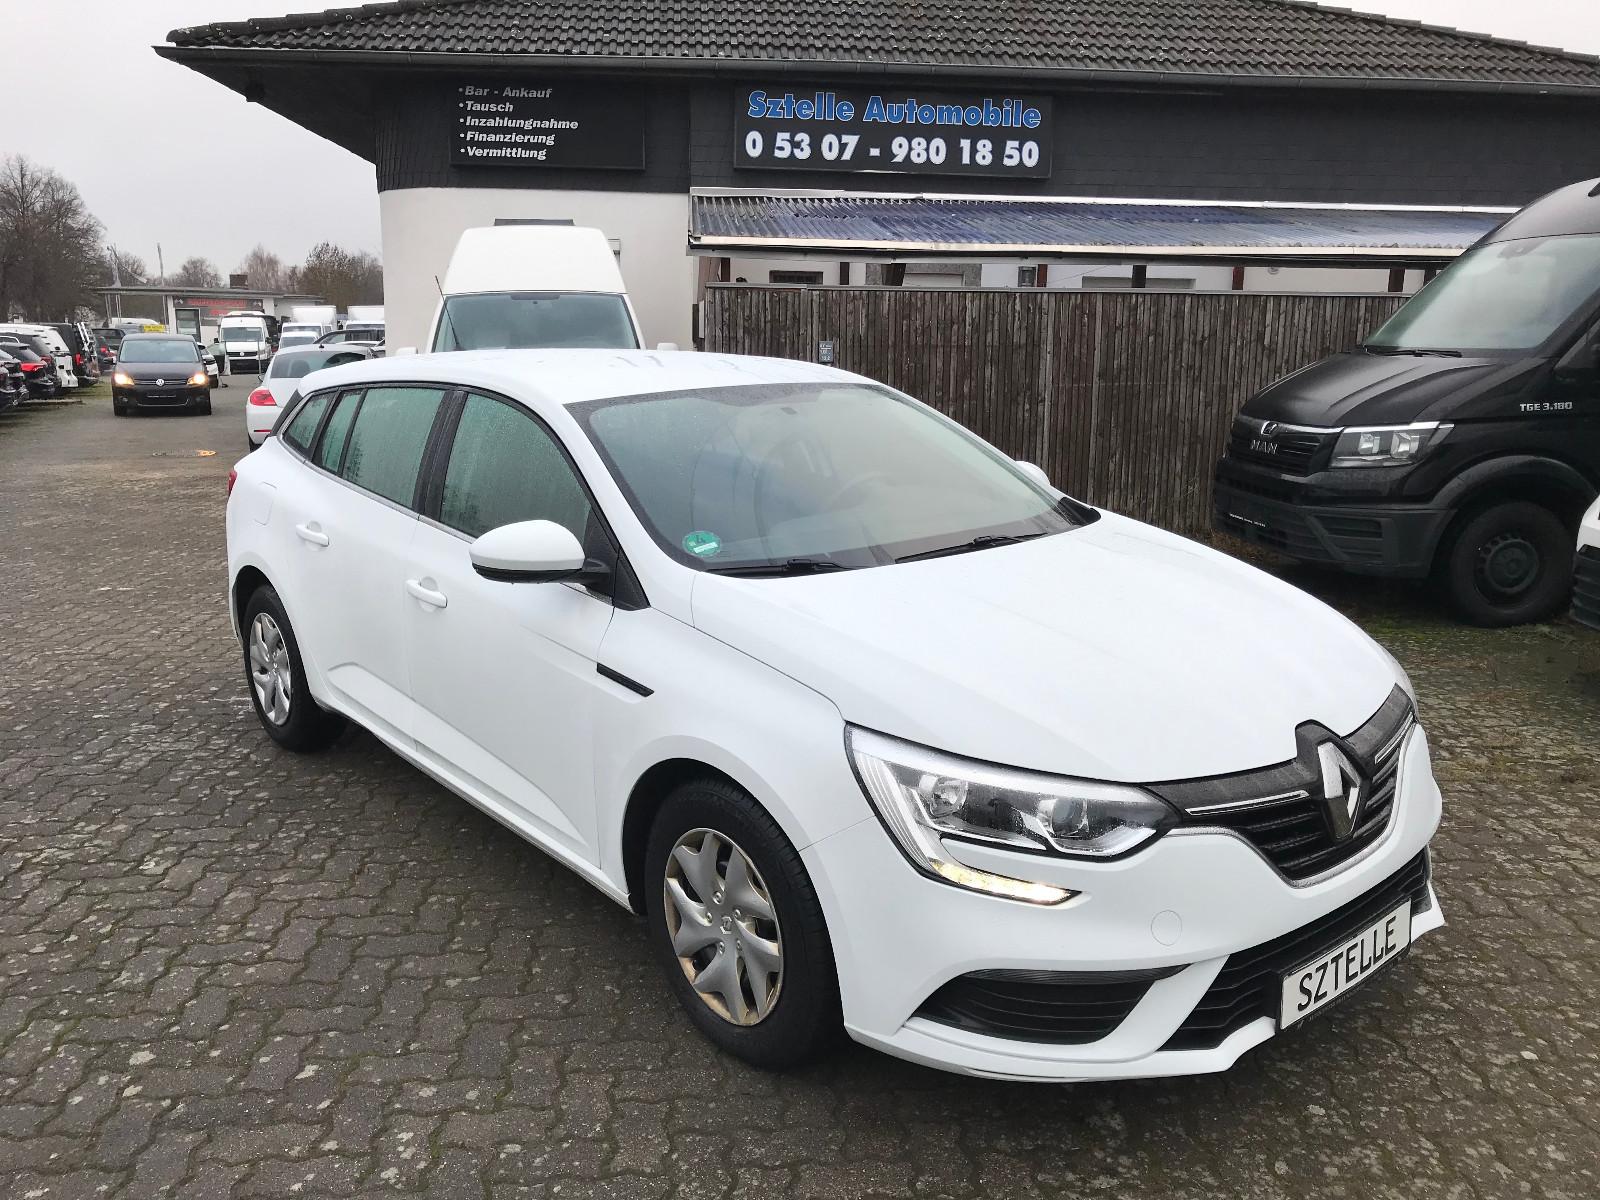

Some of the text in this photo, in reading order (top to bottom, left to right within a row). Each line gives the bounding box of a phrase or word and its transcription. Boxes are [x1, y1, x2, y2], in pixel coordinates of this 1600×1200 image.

[465, 86, 490, 96] Bar
[502, 86, 552, 98] Ankauf
[465, 101, 514, 112] Tausch
[748, 90, 1042, 129] Sztelle Automobile
[465, 116, 579, 130] Inzahlungnahme
[466, 131, 556, 146] Finanzierung
[466, 146, 547, 161] Vermittlung
[745, 131, 763, 158] 0
[774, 132, 811, 160] 53
[821, 134, 860, 161] 07
[891, 136, 947, 165] 980
[960, 138, 993, 165] 18
[1003, 140, 1039, 168] 50
[1519, 403, 1541, 412] TGE
[1297, 915, 1397, 1012] SZTELLE
